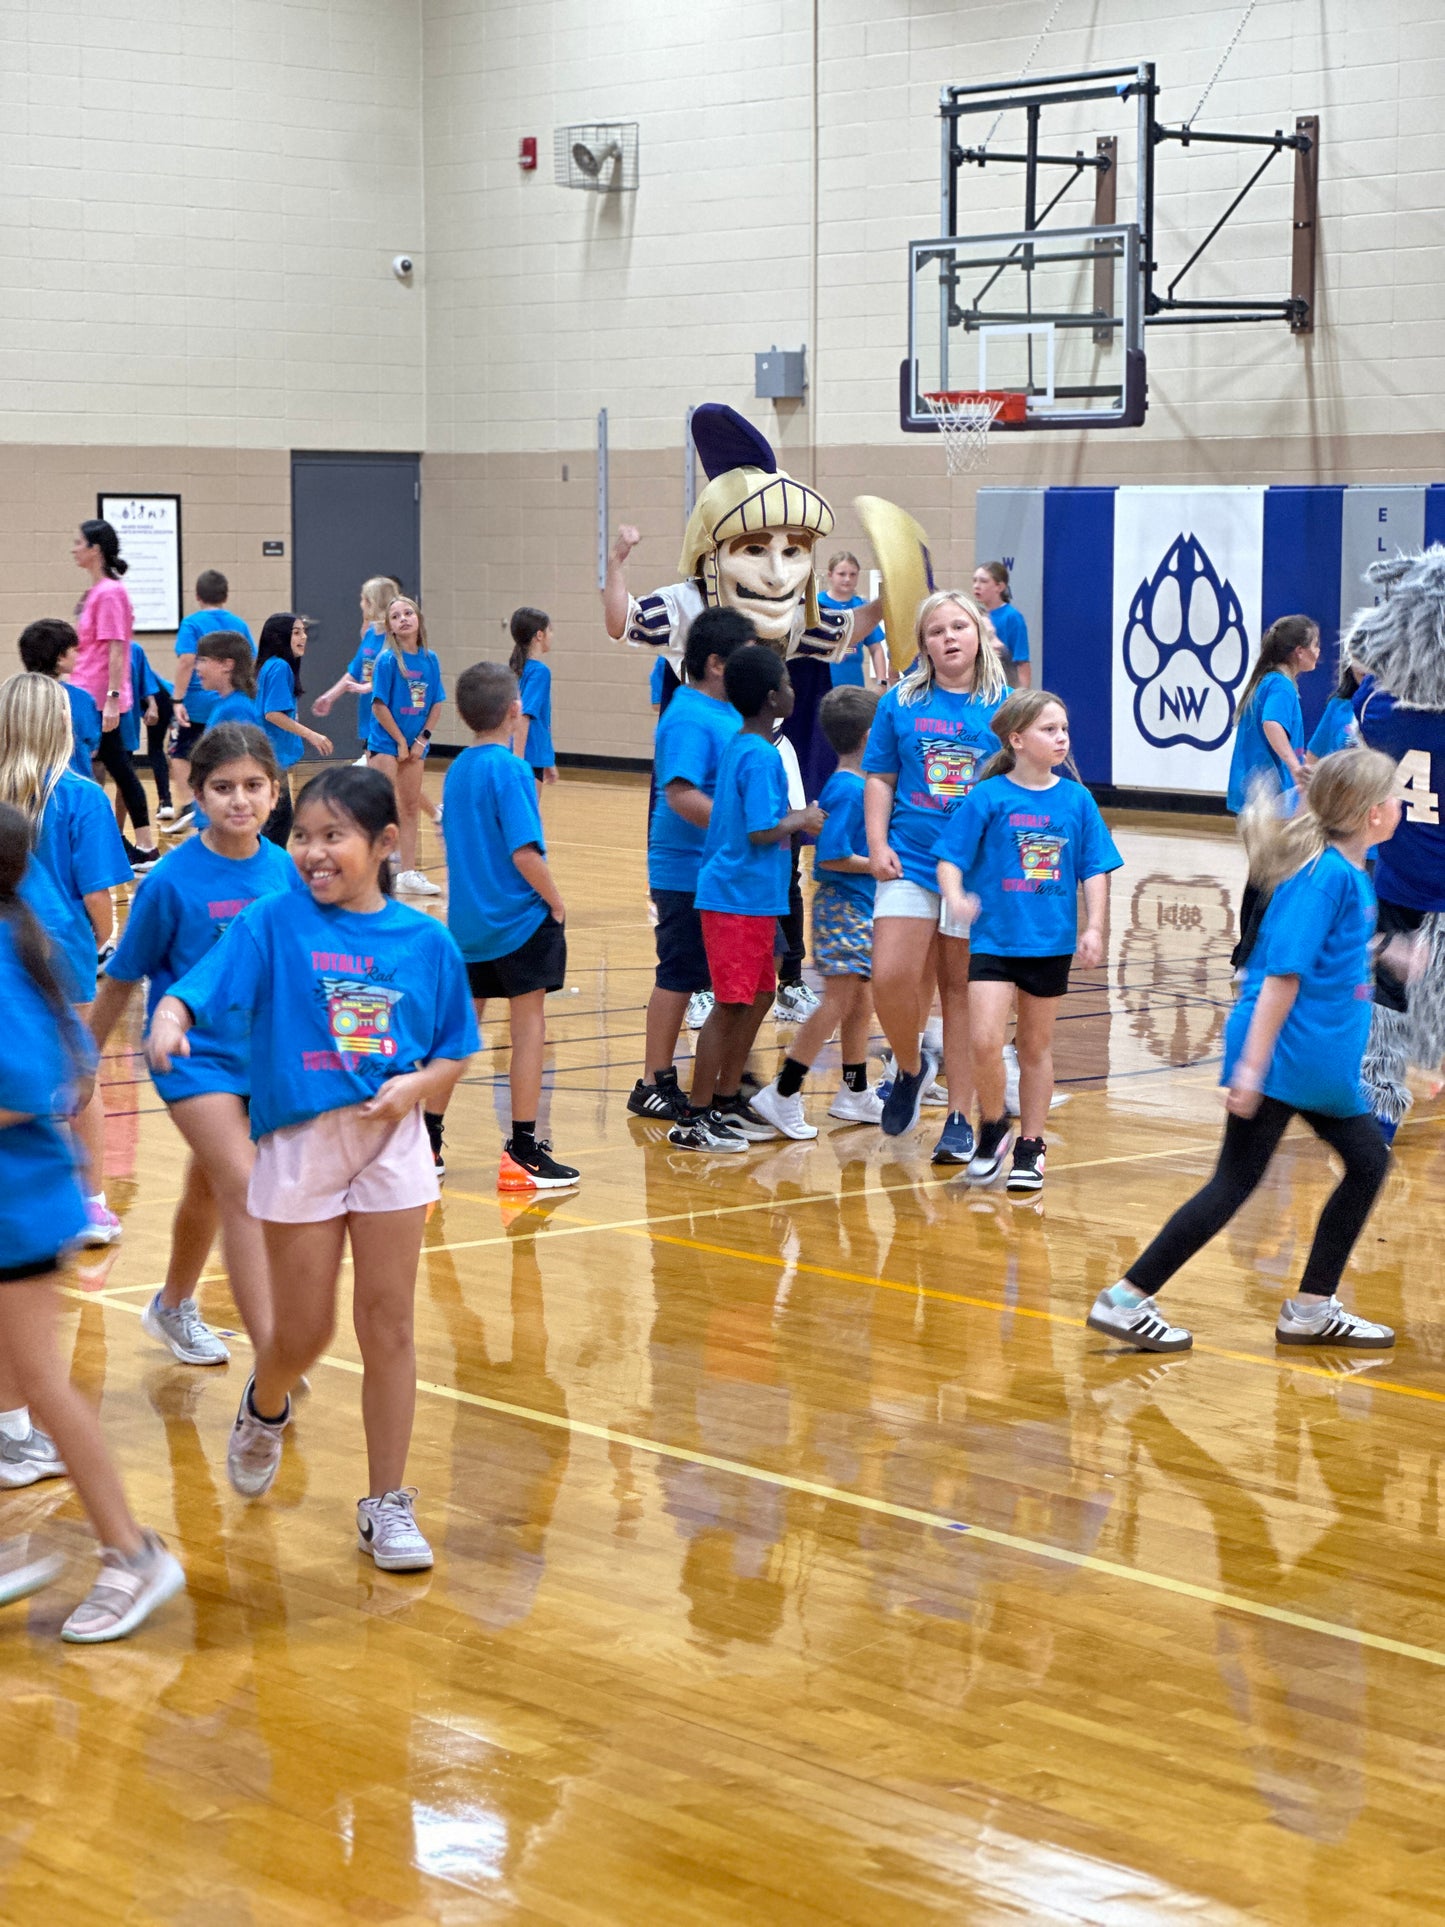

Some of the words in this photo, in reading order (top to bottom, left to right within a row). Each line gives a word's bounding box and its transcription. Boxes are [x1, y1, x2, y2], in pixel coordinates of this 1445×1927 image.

[1159, 685, 1210, 723] NW
[914, 718, 964, 736] TOTALLY
[953, 729, 983, 743] Rad
[1391, 749, 1440, 825] 4
[311, 951, 374, 974] TOTALLY
[362, 966, 398, 982] Rad
